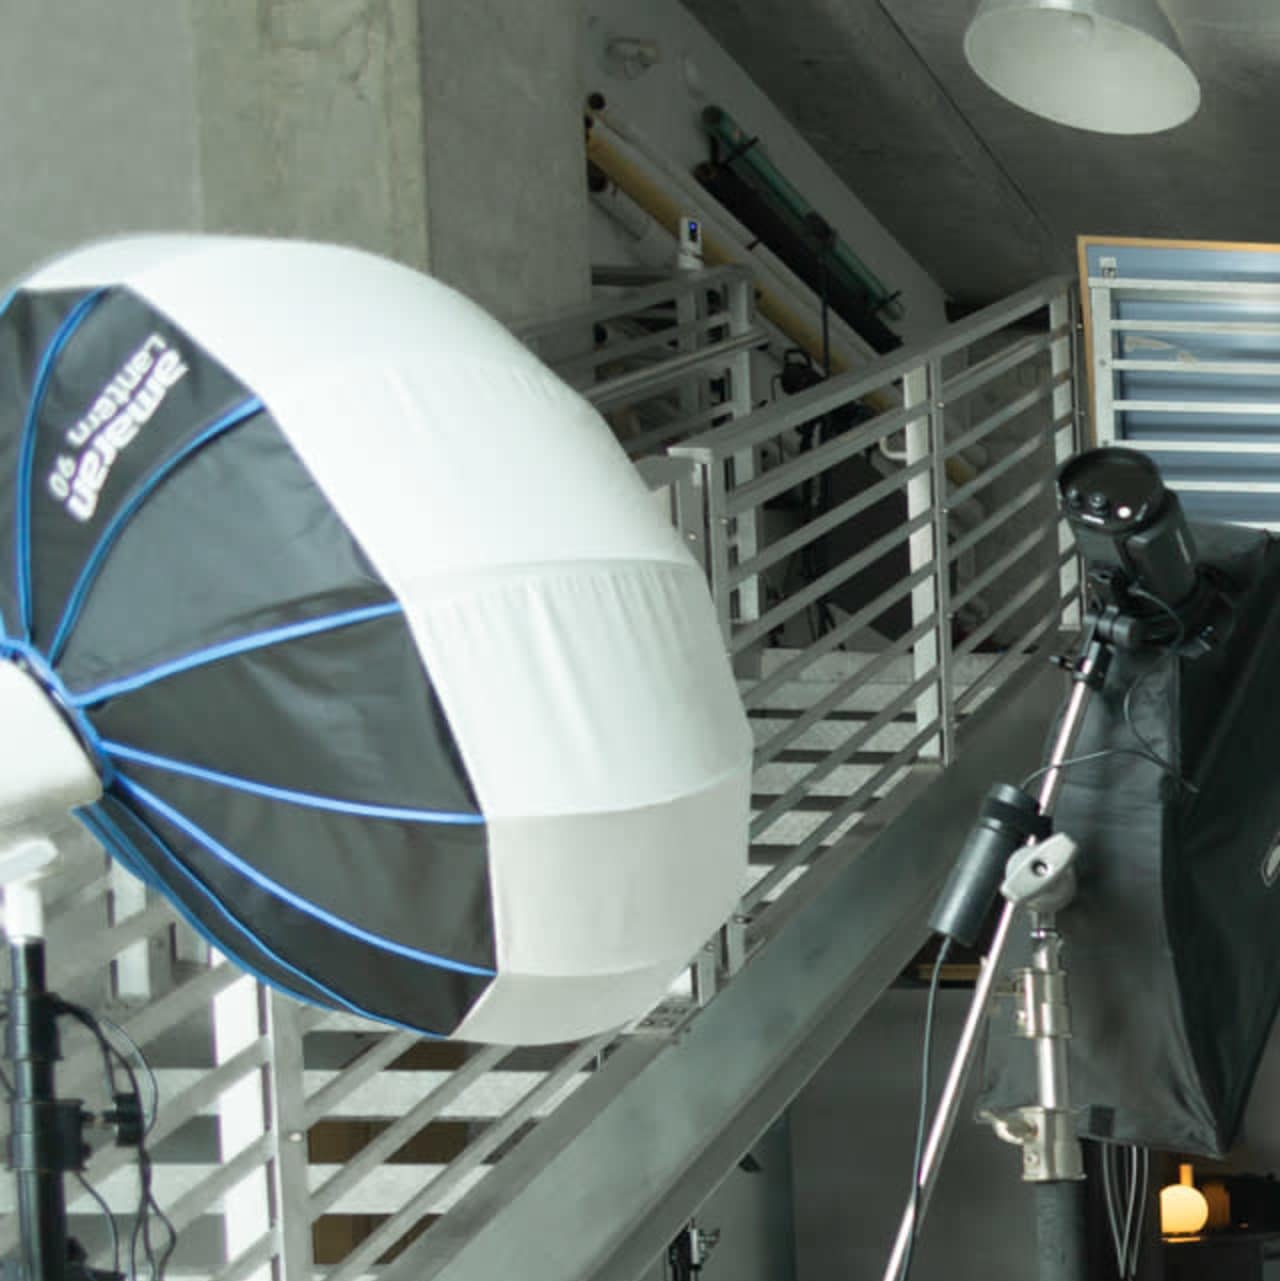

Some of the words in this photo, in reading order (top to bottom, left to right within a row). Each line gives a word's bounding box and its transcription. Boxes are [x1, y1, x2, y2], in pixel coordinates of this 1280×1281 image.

[67, 333, 166, 445] Lantern
[67, 350, 188, 520] amaran
[50, 456, 76, 497] 90
